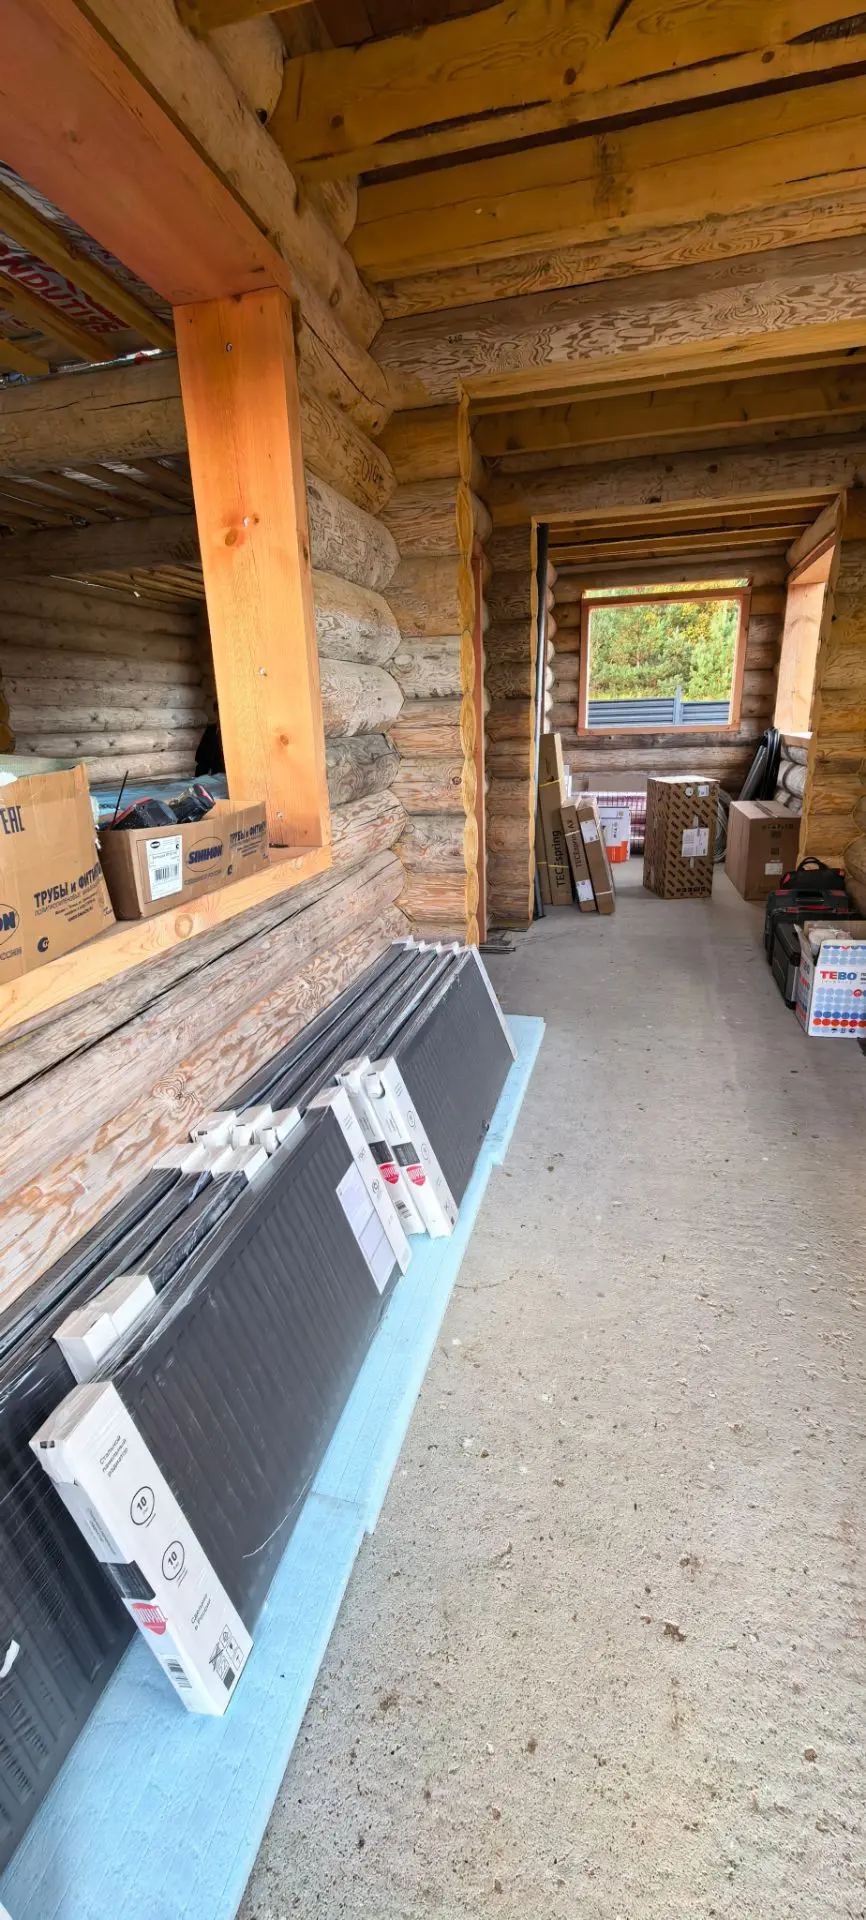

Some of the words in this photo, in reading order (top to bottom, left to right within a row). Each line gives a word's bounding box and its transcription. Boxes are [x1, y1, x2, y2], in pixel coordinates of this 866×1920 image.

[34, 882, 68, 907] ТРУБЫ
[820, 970, 857, 980] TEBO
[137, 1496, 147, 1510] 10
[168, 1551, 178, 1566] 10
